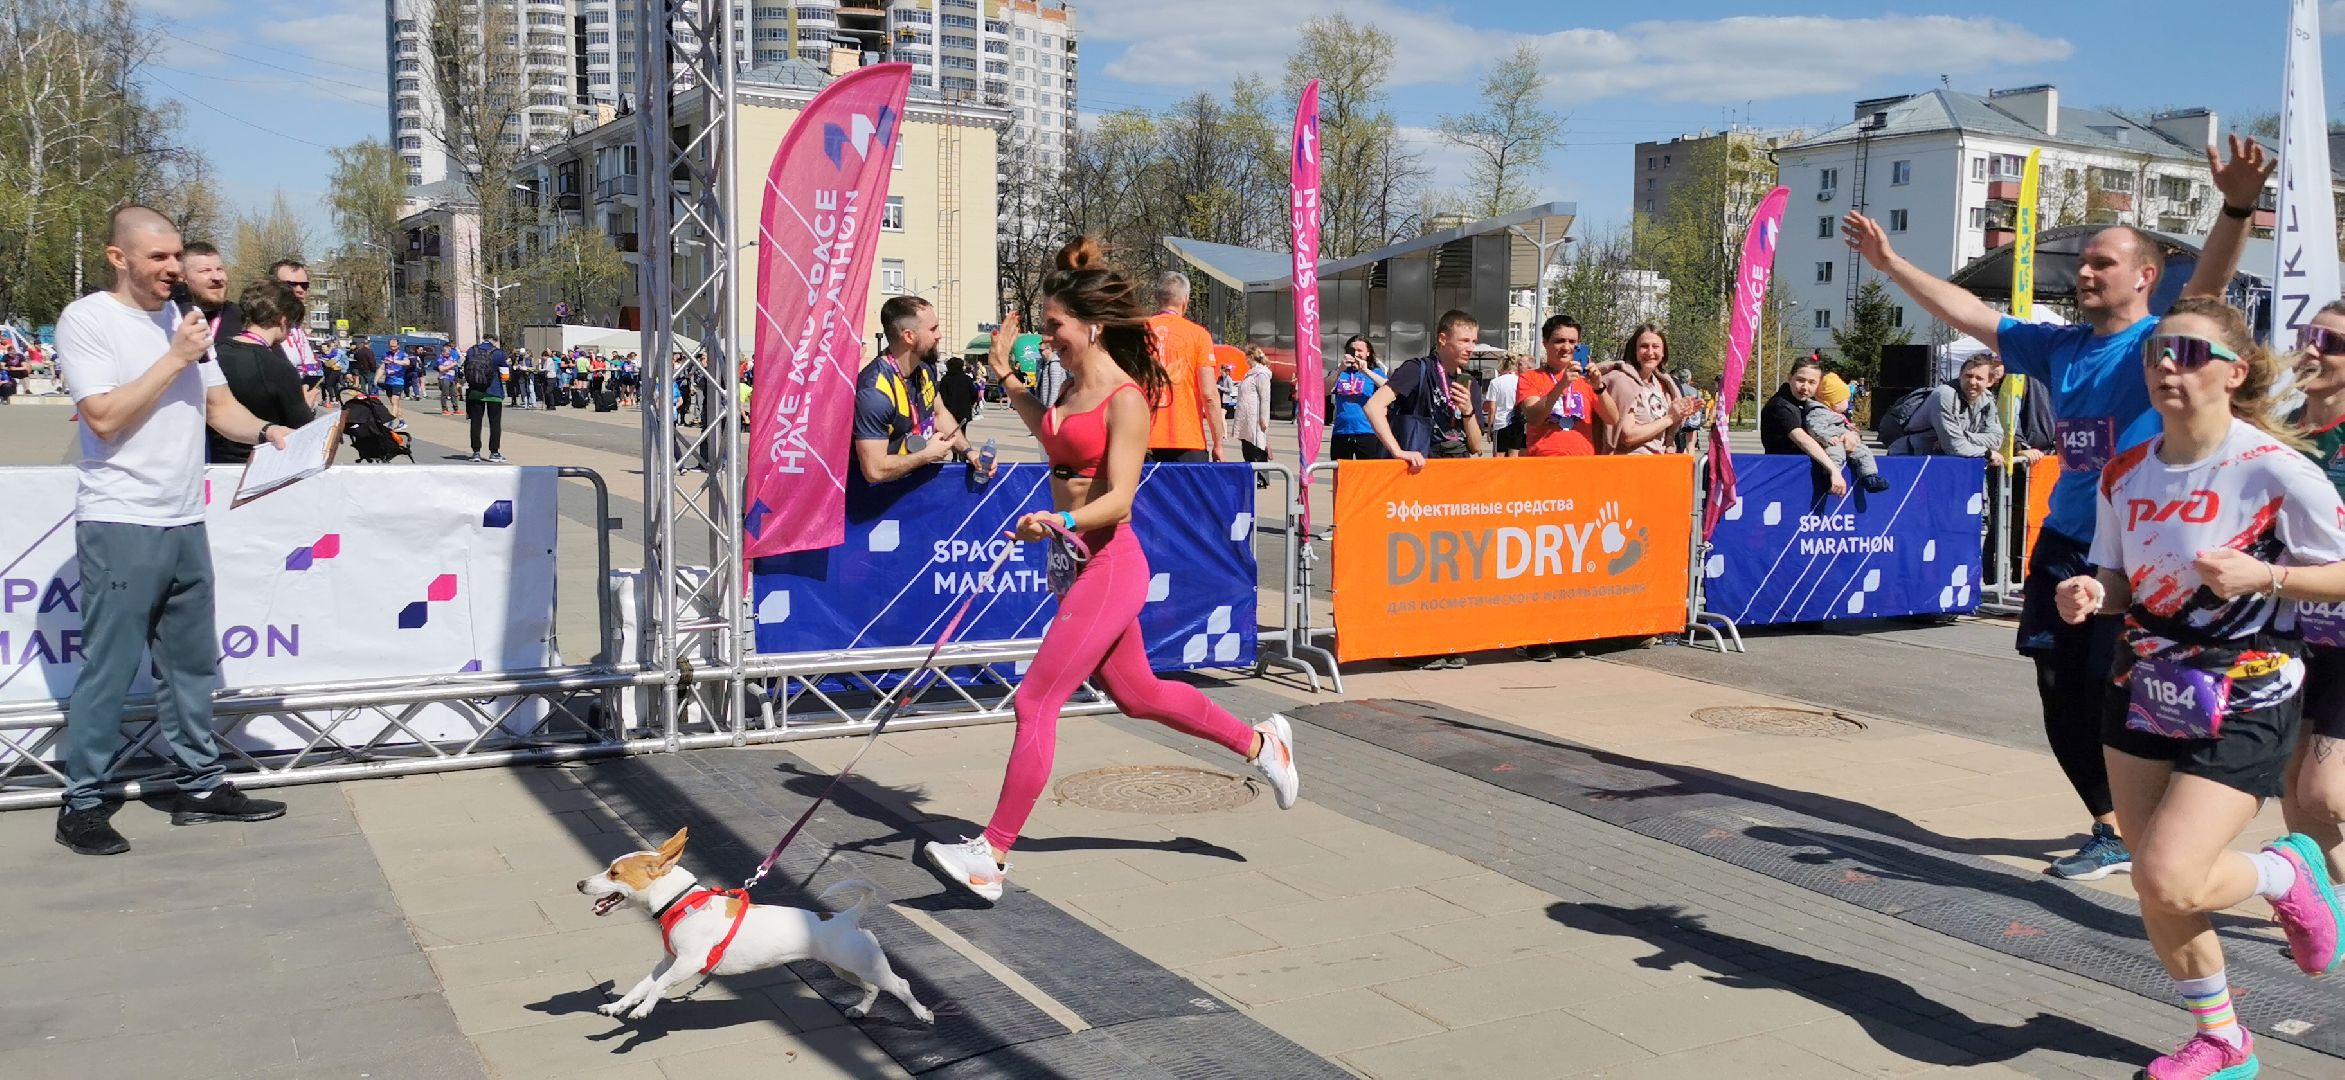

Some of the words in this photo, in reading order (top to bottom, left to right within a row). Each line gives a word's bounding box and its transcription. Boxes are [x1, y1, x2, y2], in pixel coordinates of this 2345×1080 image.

[770, 393, 801, 464] OVE
[2061, 430, 2096, 448] 1431
[1386, 500, 1503, 522] Эффективные
[1506, 498, 1574, 517] средства
[1800, 514, 1855, 533] SPACE
[933, 540, 1025, 563] SPACE
[1800, 535, 1894, 555] MARATHON
[934, 570, 1048, 594] MARATH
[1387, 601, 1416, 615] для
[1420, 592, 1539, 611] косметического
[2143, 677, 2196, 710] 1184
